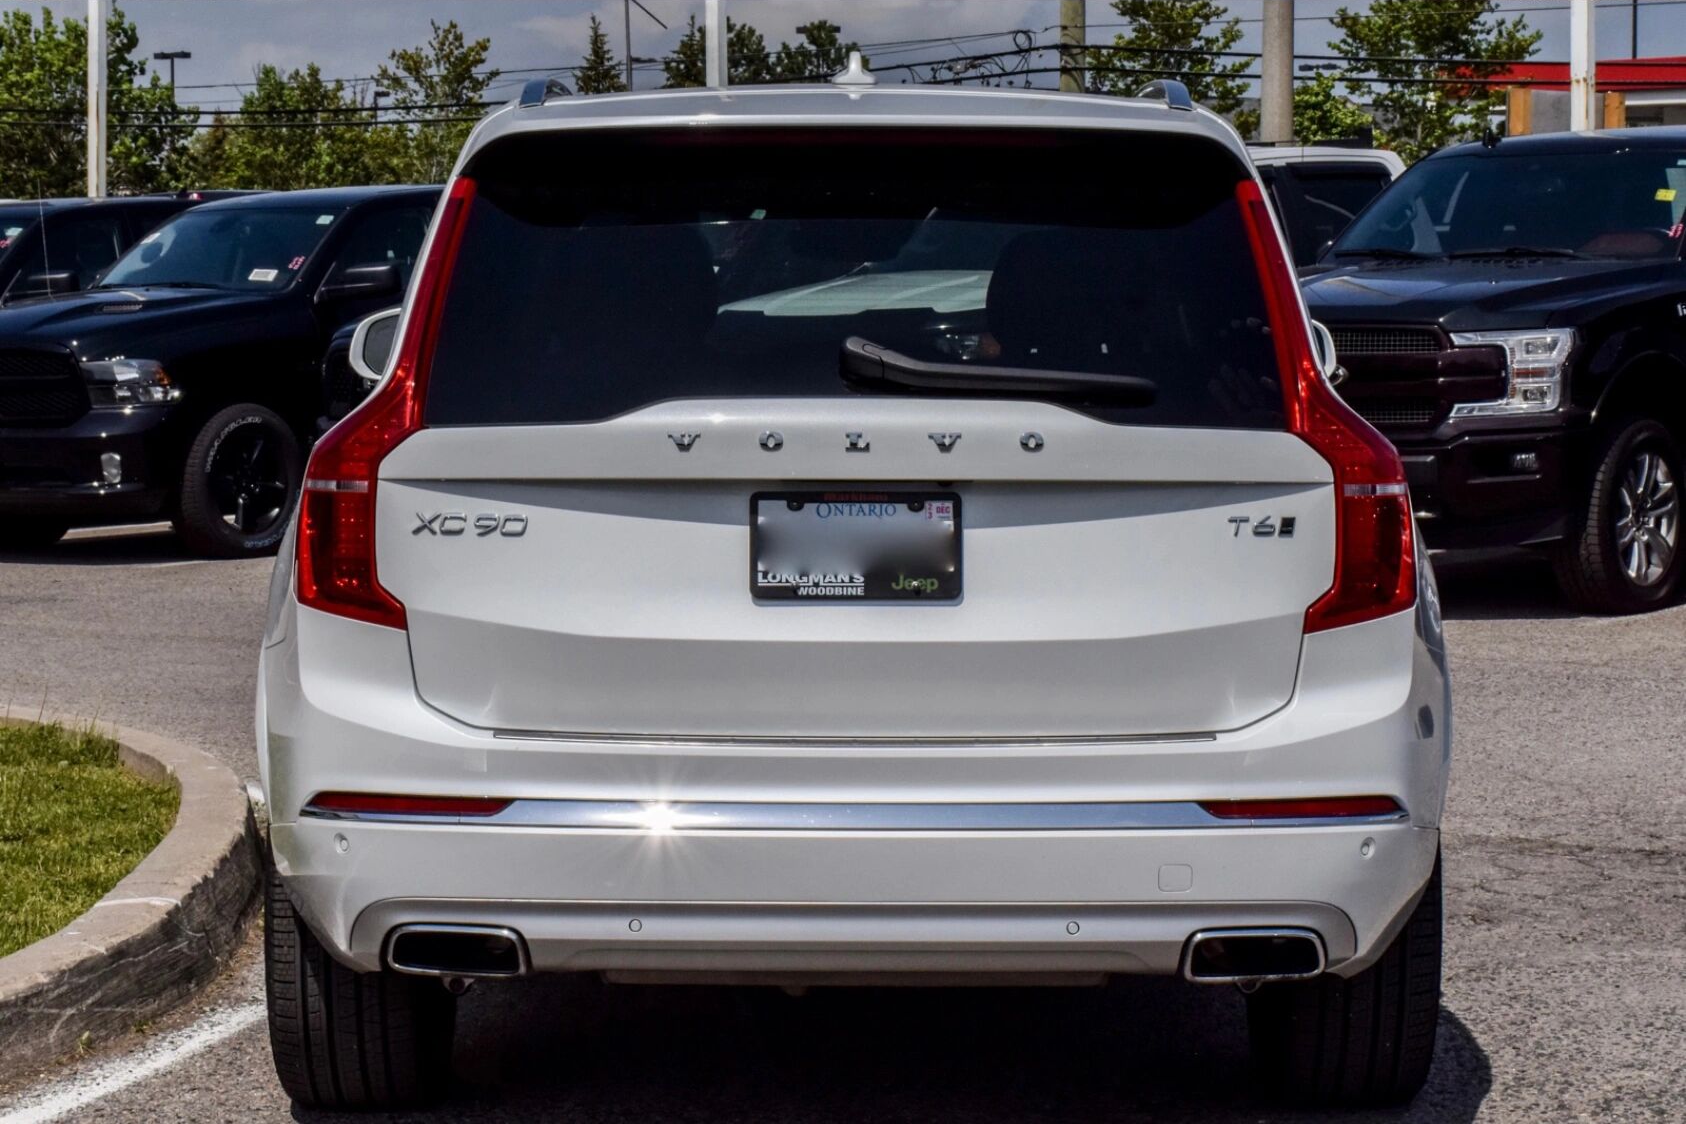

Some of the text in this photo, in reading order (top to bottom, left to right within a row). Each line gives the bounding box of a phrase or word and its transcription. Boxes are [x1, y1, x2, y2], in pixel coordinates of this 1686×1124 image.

[667, 430, 1045, 454] VOLVO
[815, 502, 897, 519] ONTARIO
[1227, 515, 1276, 538] T6
[797, 586, 865, 596] WOODBINE
[891, 574, 939, 592] Jeep
